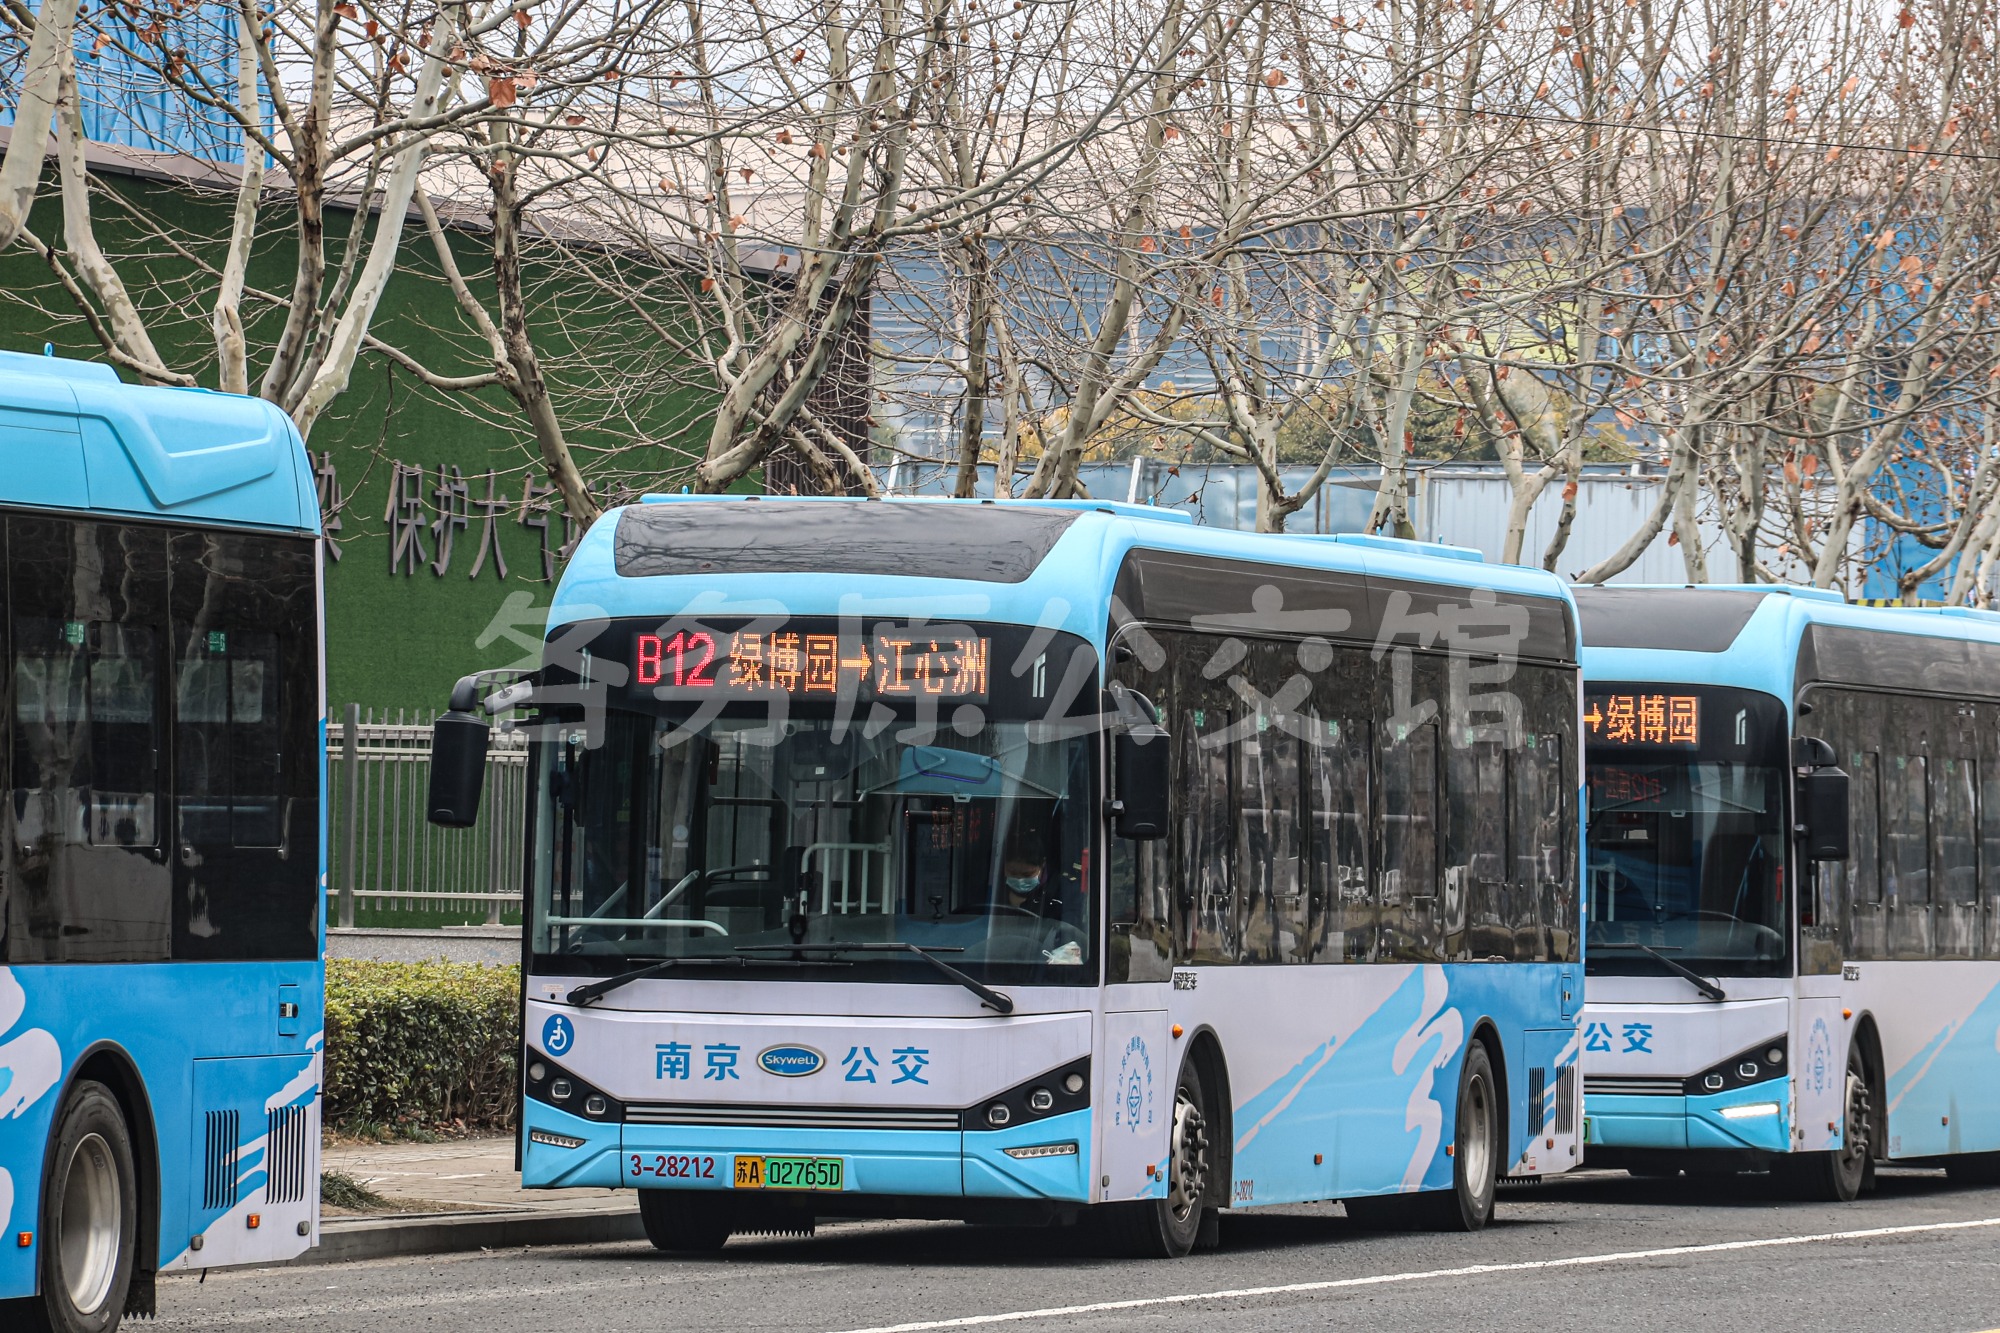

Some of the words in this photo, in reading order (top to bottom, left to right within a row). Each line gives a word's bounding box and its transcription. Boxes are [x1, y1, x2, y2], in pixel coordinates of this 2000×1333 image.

[384, 459, 633, 582] 保护大气
[638, 632, 715, 686] B12
[729, 632, 838, 692] 绿博园
[1606, 694, 1698, 744] 绿博园
[1584, 1023, 1653, 1053] 公交
[655, 1042, 741, 1081] 南京
[842, 1046, 930, 1085] 公交
[630, 1155, 715, 1178] 3-28212
[736, 1161, 760, 1184] 苏A
[770, 1162, 840, 1186] 02765D
